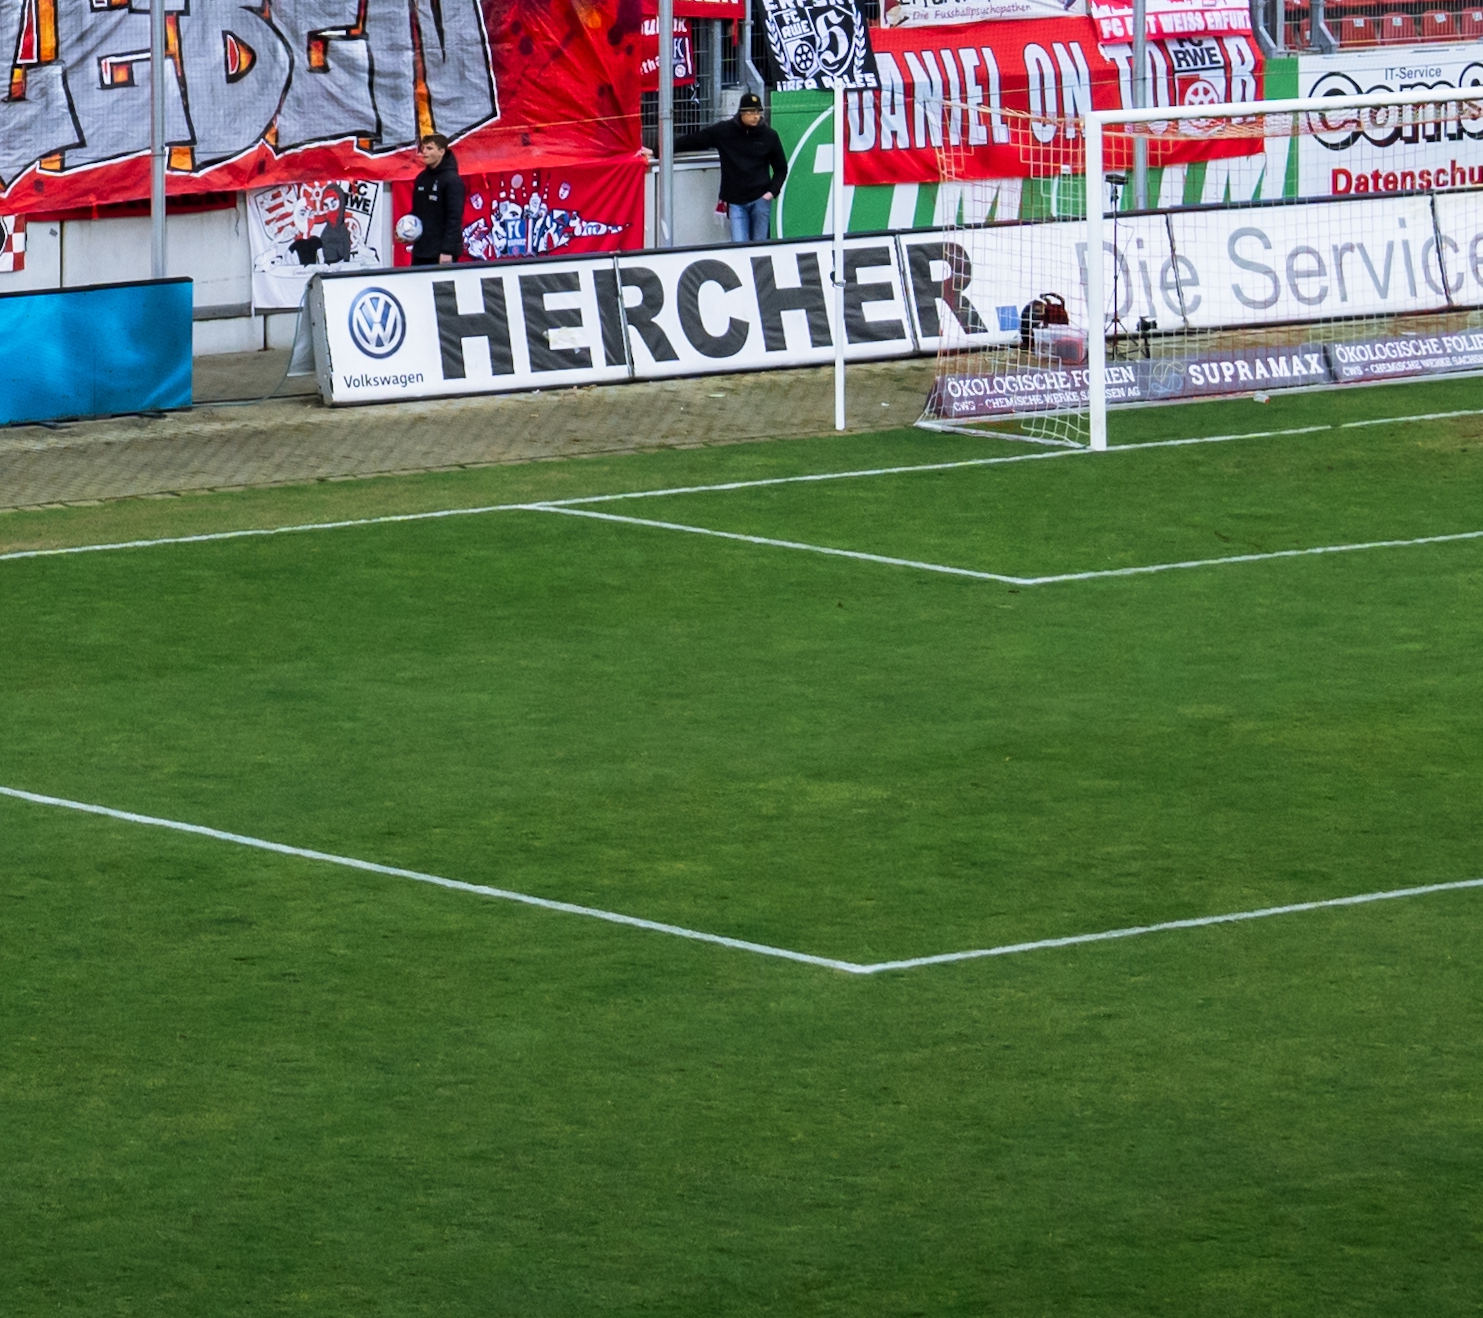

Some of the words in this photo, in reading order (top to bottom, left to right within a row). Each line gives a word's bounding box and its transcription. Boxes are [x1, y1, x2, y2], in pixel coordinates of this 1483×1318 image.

[782, 10, 801, 25] FC
[912, 11, 930, 21] Die
[1099, 17, 1124, 39] FC
[1158, 10, 1206, 34] WEISS
[1204, 9, 1251, 31] ERFURT
[781, 19, 814, 40] RWE
[1172, 45, 1222, 69] RWE
[1385, 65, 1442, 81] IT-Service
[845, 40, 1010, 153] DANIEL
[1023, 40, 1094, 144] ON
[1076, 220, 1203, 320] Die
[432, 243, 988, 381] HERCHER
[1334, 337, 1443, 364] ÖKOLOGISCHE
[1188, 352, 1326, 388] SUPRAMAX
[1342, 364, 1364, 377] CWS
[1370, 359, 1421, 374] CHEMISCHE
[1420, 357, 1453, 369] WERKE
[343, 369, 425, 390] Volkswagen
[946, 369, 1071, 398] ÖKOLOGISCHE
[1127, 385, 1141, 397] AG
